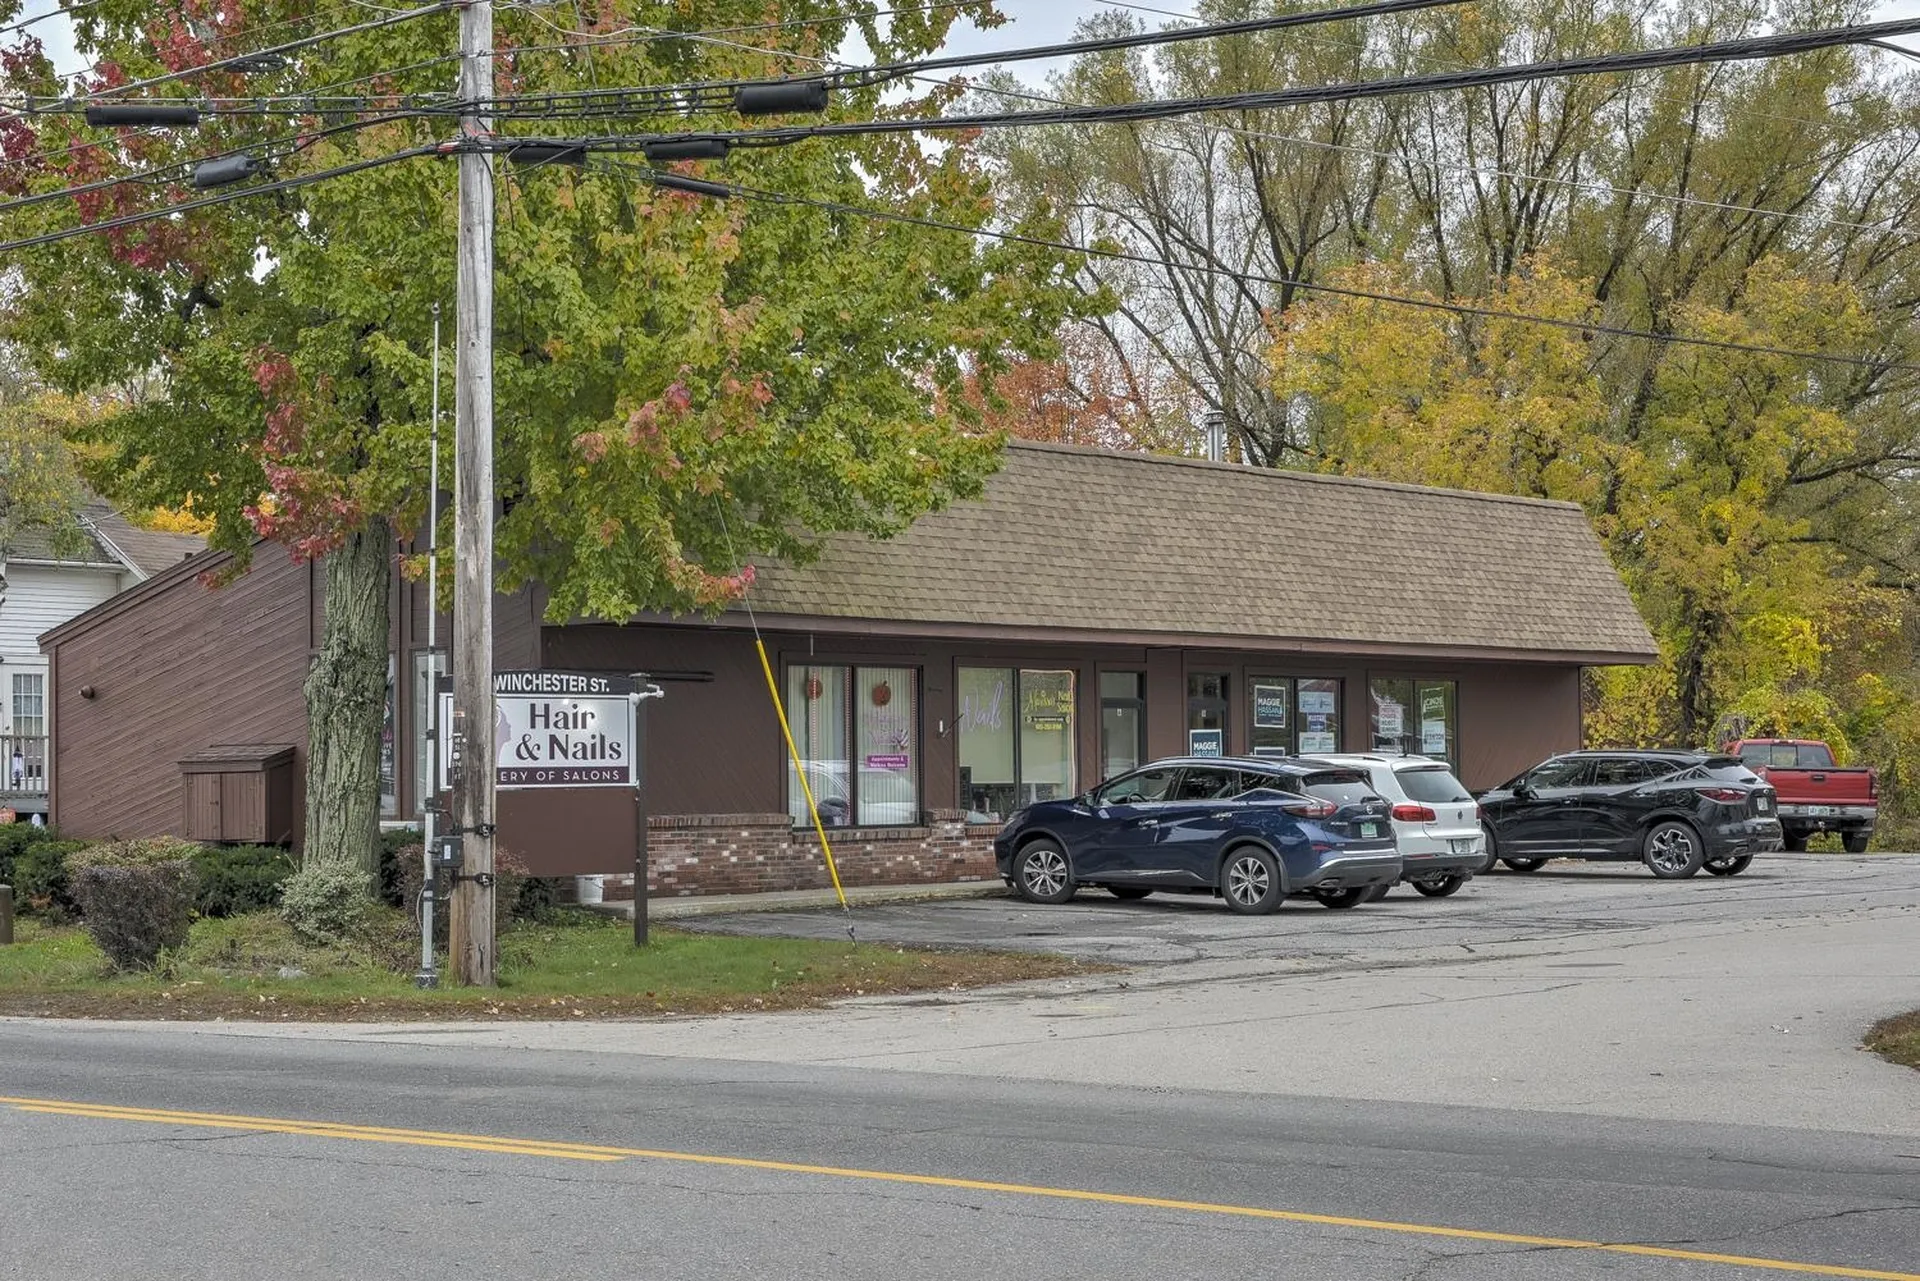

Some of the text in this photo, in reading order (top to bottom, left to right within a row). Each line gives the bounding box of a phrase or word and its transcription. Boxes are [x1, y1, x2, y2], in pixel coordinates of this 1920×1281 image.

[494, 673, 610, 692] WINCHESTER ST.
[1257, 697, 1281, 706] MAGGIE
[530, 703, 595, 730] Hair
[515, 732, 622, 761] & Nails
[1193, 741, 1217, 750] MAGGIE
[500, 770, 620, 781] ERY OF SALONS
